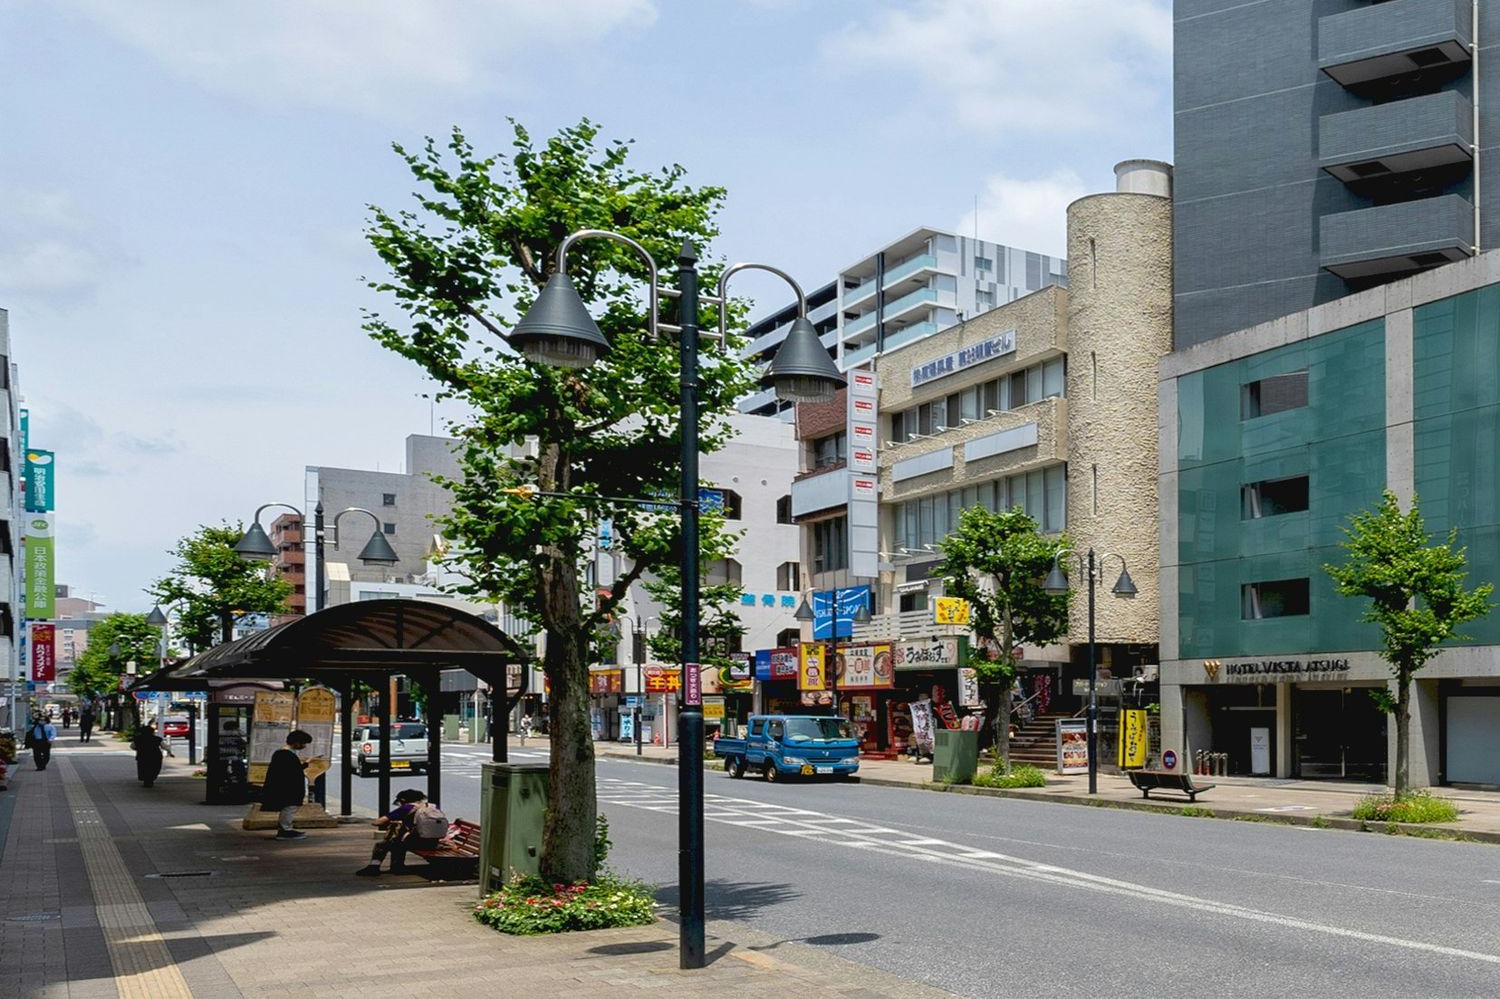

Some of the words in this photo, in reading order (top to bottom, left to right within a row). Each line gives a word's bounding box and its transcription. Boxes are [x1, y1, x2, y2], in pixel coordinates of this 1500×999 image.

[1226, 663, 1262, 675] HOTEL
[1262, 660, 1301, 674] VISTA
[1303, 658, 1350, 672] ATSUGI
